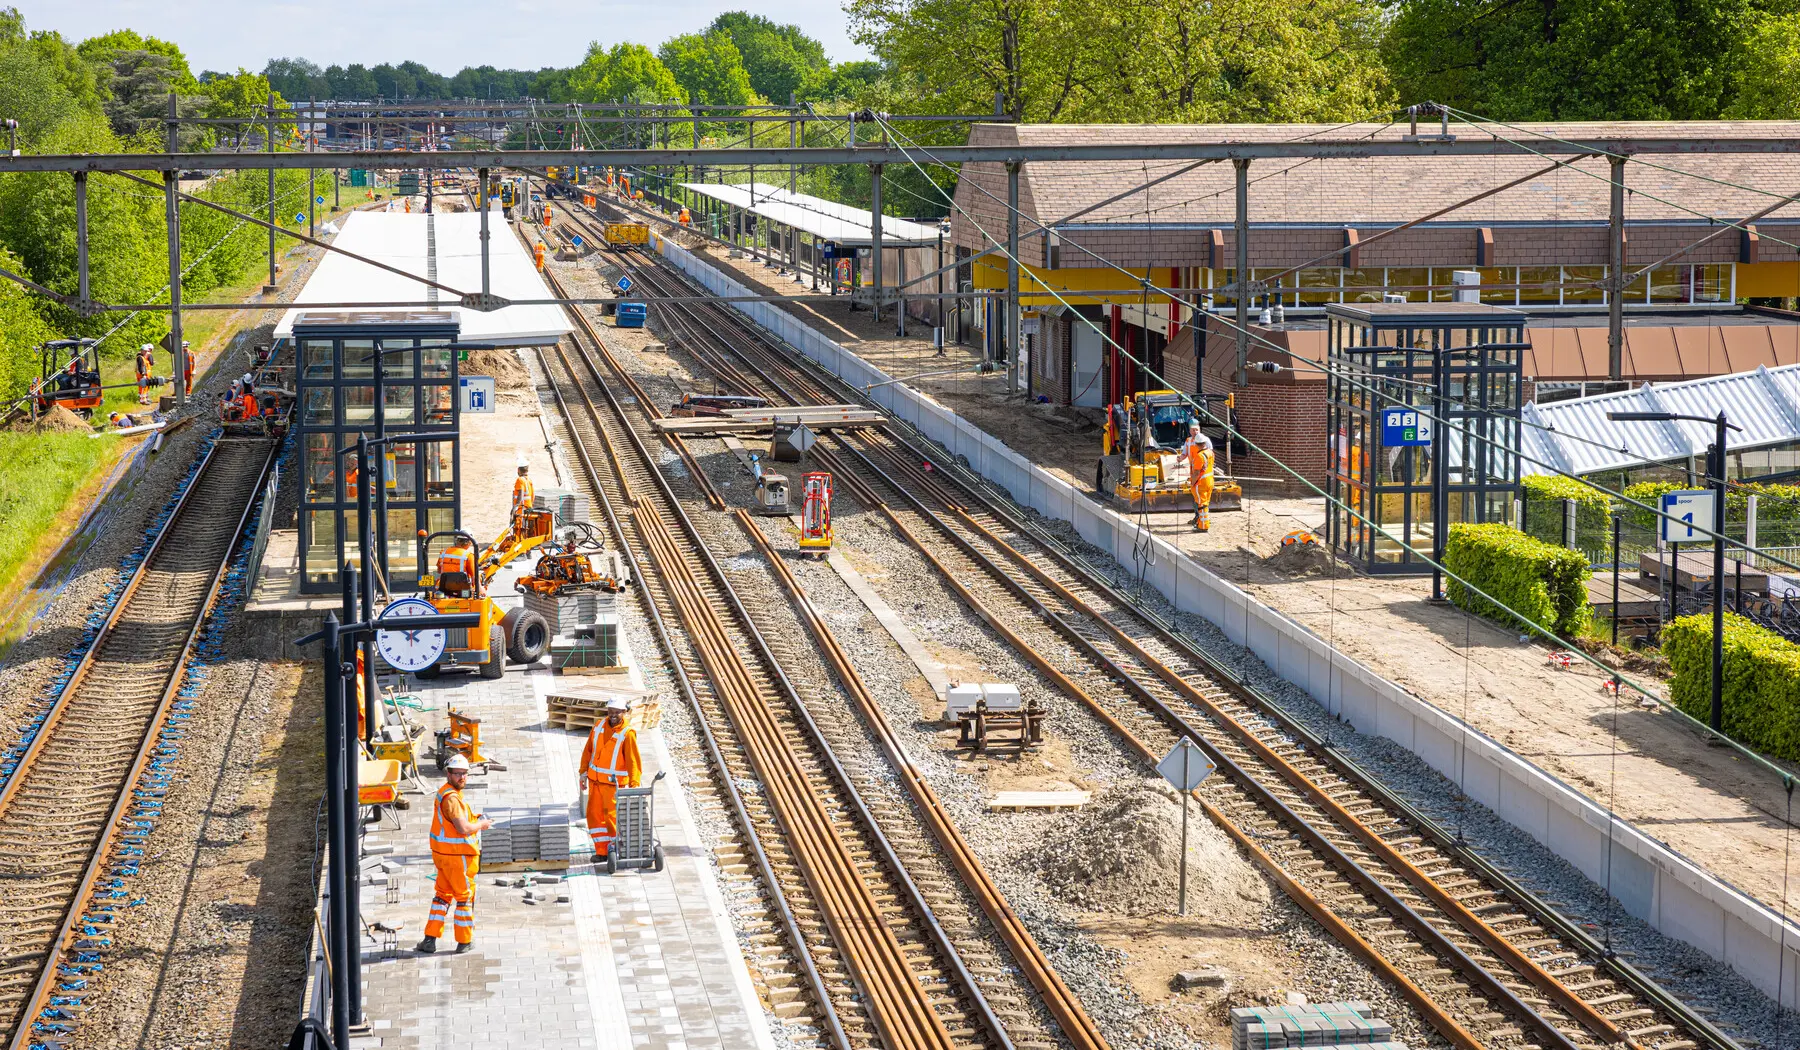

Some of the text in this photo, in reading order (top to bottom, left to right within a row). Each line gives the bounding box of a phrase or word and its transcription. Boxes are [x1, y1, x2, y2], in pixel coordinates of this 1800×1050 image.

[622, 280, 628, 288] 2
[1391, 416, 1412, 425] 2 3
[1681, 512, 1693, 537] 1
